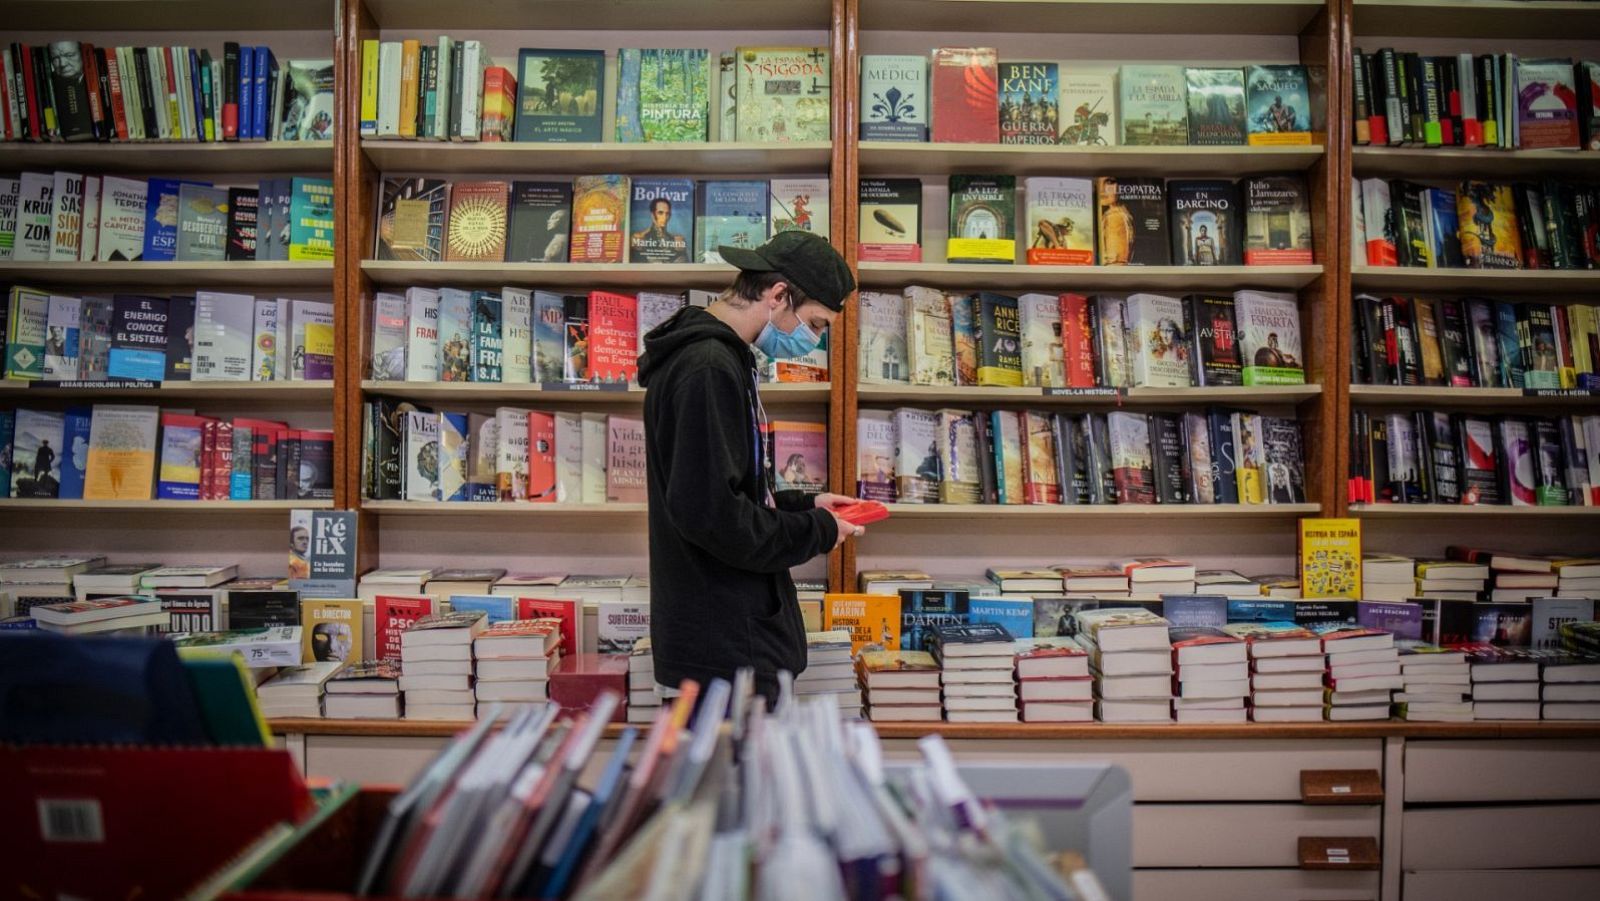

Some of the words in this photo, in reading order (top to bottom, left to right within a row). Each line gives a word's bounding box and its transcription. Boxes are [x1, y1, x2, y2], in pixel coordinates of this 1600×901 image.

[744, 64, 824, 76] VISIGODA
[868, 70, 920, 80] MEDICI
[1011, 66, 1047, 79] BEN
[1424, 62, 1436, 81] JAMES
[1004, 78, 1052, 92] KANE
[642, 109, 700, 119] PINTURA
[1002, 122, 1054, 132] GUERRA
[1002, 135, 1055, 145] IMPERIOS
[1104, 183, 1161, 194] CLEOPATRA
[1250, 181, 1270, 189] Julio
[112, 191, 147, 202] JONATHA
[634, 188, 689, 204] Bolívar
[114, 198, 146, 210] TEPPE
[1176, 199, 1228, 210] BARCINO
[200, 234, 216, 245] CIVIL
[632, 240, 657, 250] Marie
[658, 240, 686, 250] Arana
[141, 301, 152, 310] EL
[124, 311, 168, 322] ENEMIGO
[602, 316, 612, 326] La
[1251, 314, 1295, 328] ESPARTA
[126, 322, 165, 333] CONOCE
[480, 322, 492, 334] LA
[117, 333, 128, 341] EL
[604, 336, 616, 345] de
[618, 338, 627, 347] la
[612, 442, 623, 453] la
[316, 517, 346, 538] Fé
[832, 608, 865, 617] MARINA
[972, 607, 1004, 616] MARTIN
[1006, 607, 1030, 616] KEMP
[252, 649, 263, 657] 75
